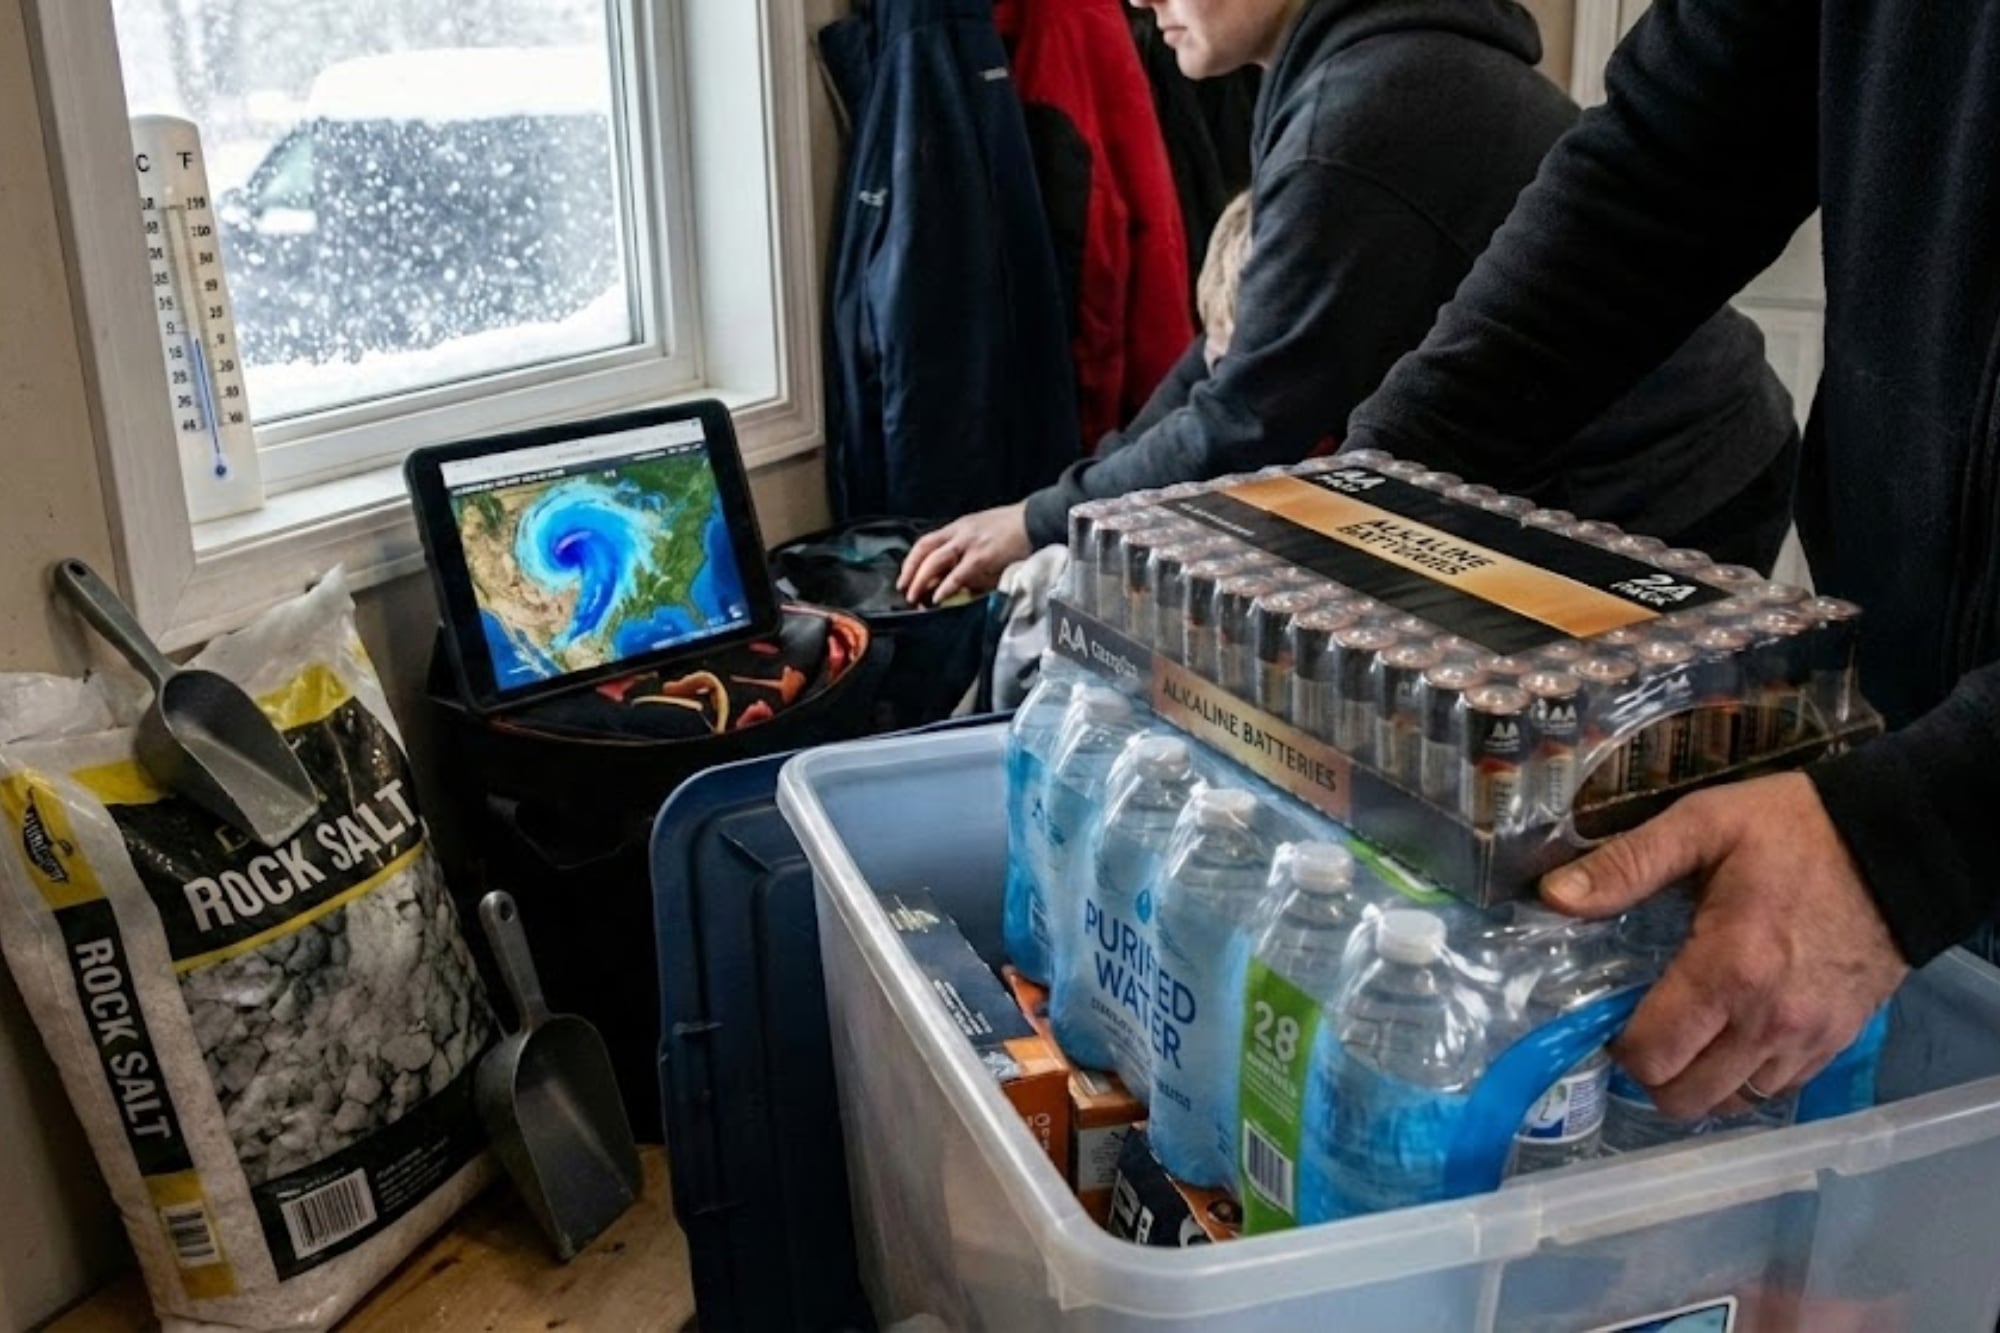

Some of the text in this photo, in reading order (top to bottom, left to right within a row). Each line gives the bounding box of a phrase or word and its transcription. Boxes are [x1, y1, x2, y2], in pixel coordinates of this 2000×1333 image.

[1058, 617, 1088, 659] AA
[1162, 676, 1337, 792] ALKALINE BATTERIES
[183, 779, 416, 932] ROCK SALT
[76, 936, 172, 1138] ROCK SALT
[1254, 1000, 1300, 1062] 28
